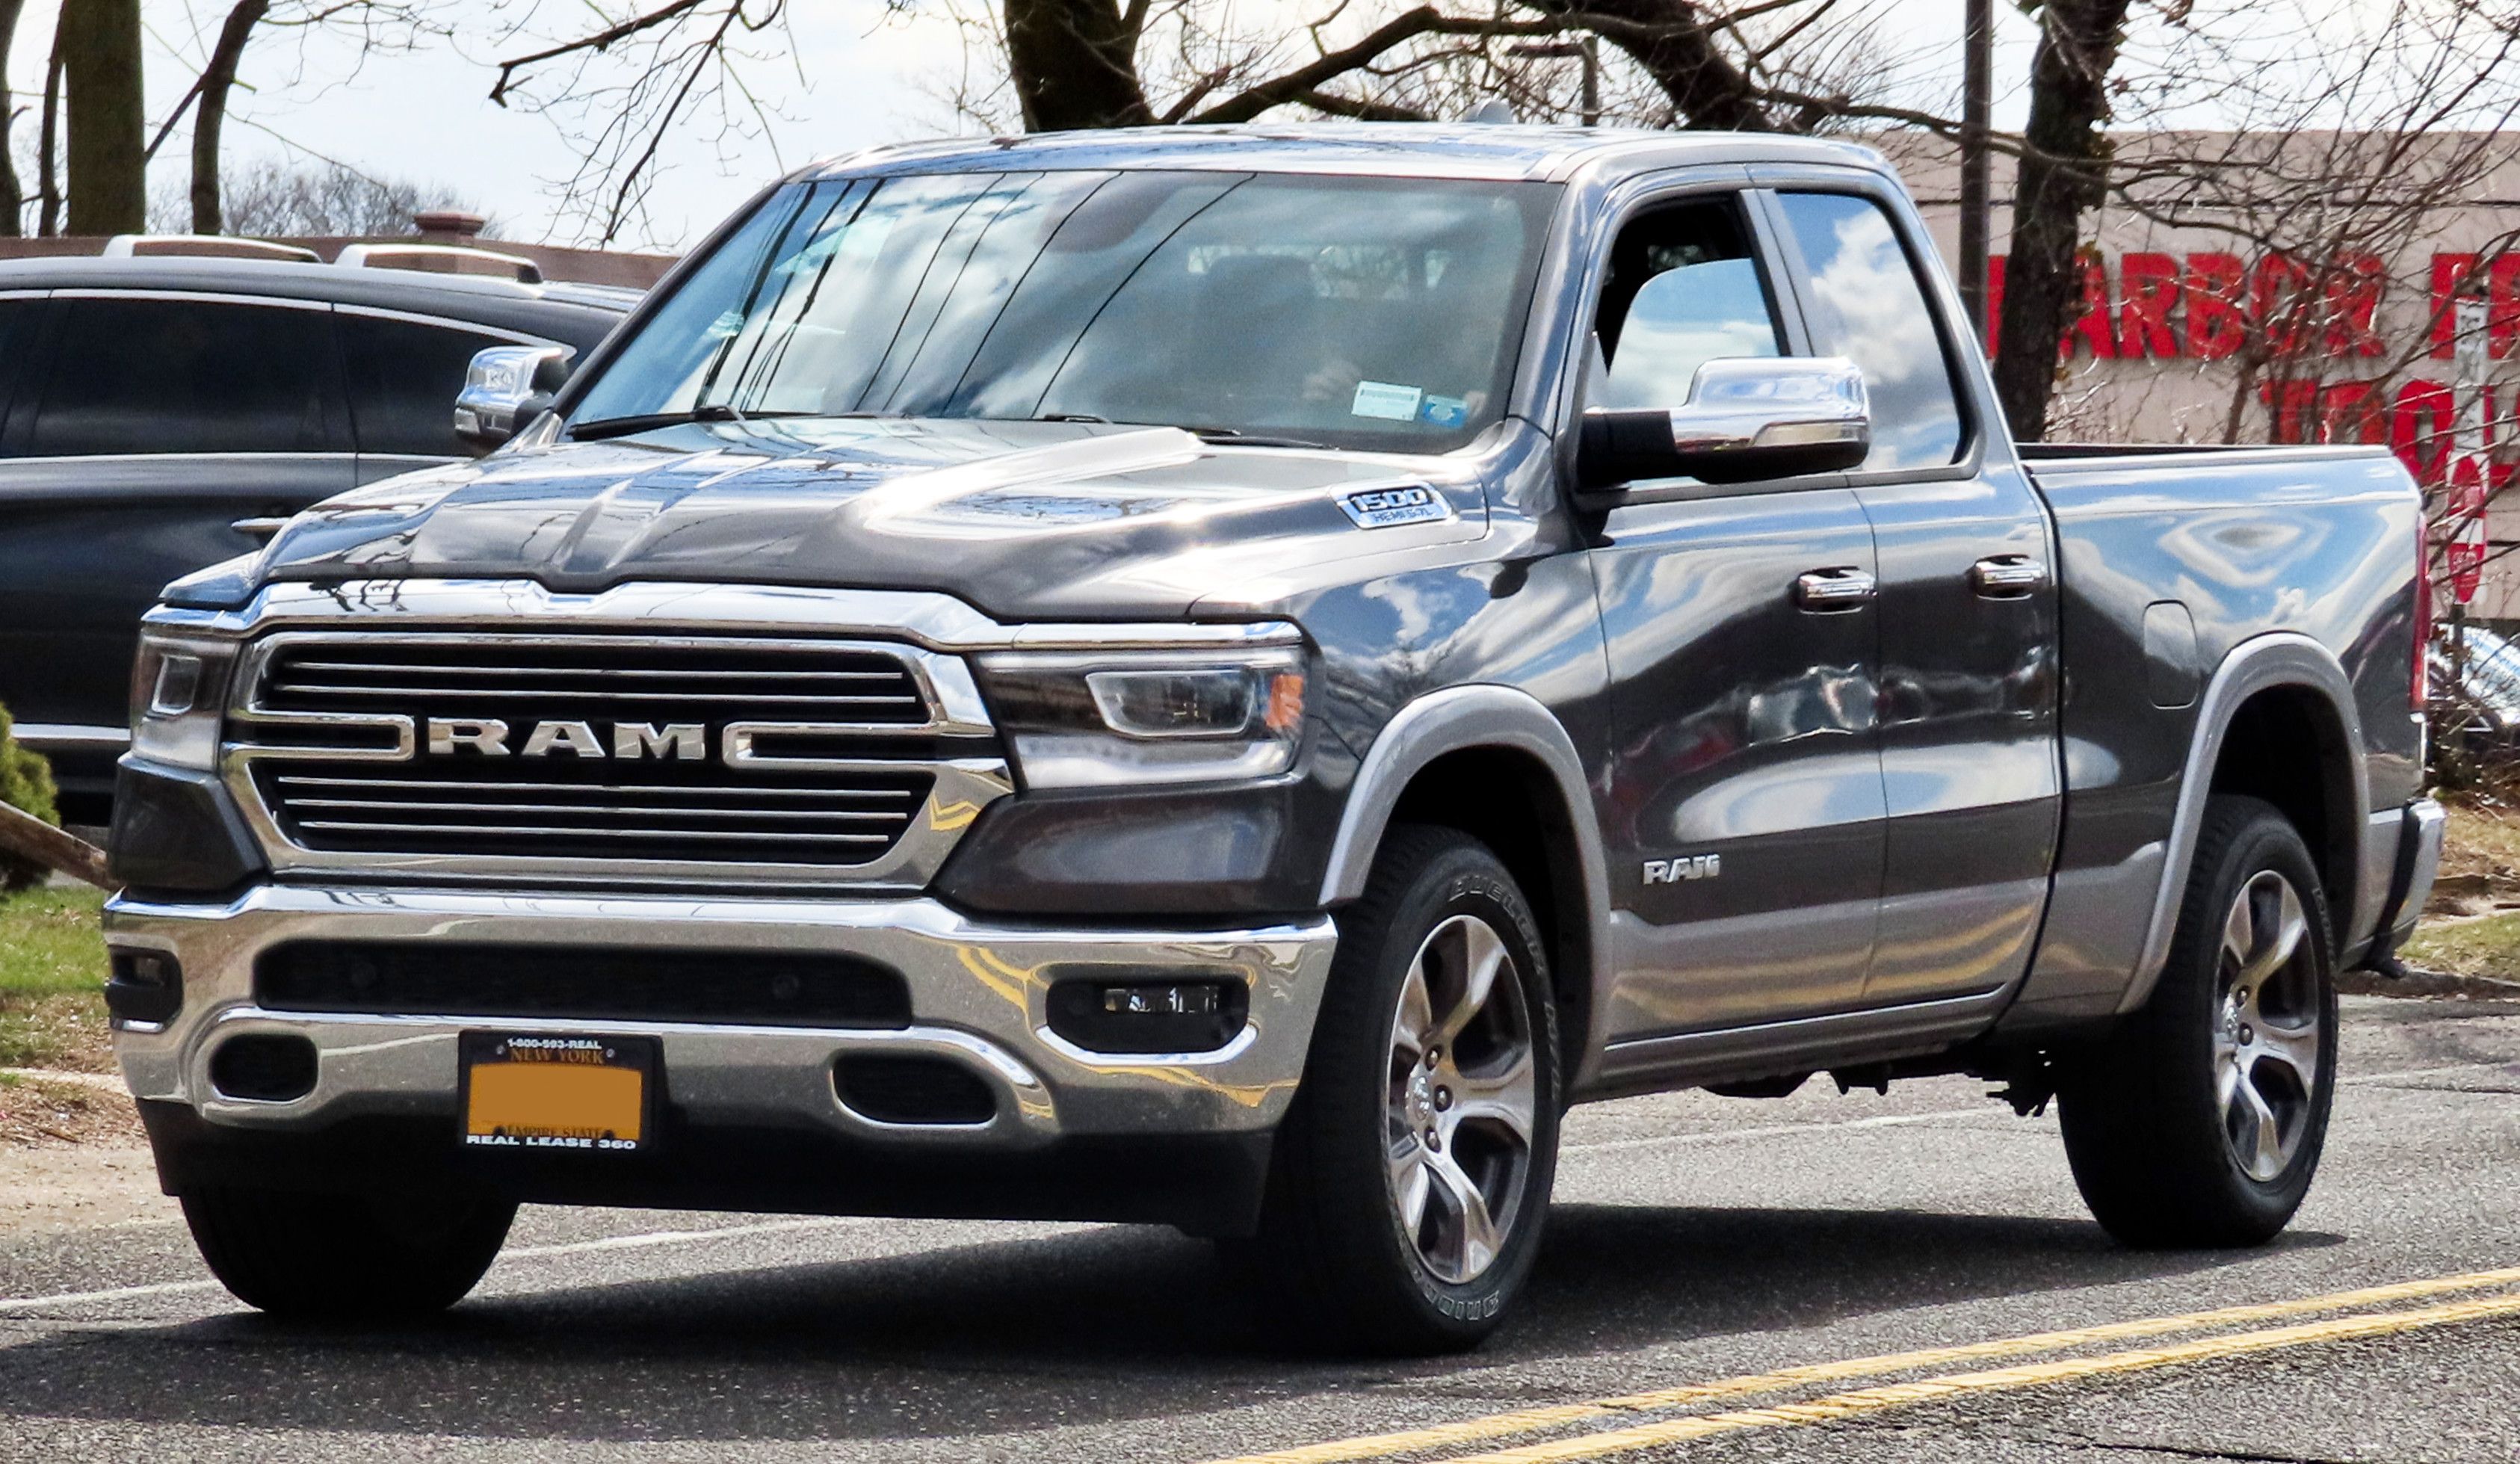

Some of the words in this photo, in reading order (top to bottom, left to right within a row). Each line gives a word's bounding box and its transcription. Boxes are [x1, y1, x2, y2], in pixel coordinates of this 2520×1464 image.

[1987, 252, 2386, 359] ARBOR
[1350, 488, 1429, 513] 1500
[428, 717, 705, 759] RAM
[1643, 853, 1720, 885] RAM
[510, 1047, 554, 1062] NEW
[558, 1048, 605, 1064] YORK
[466, 1134, 520, 1146] REAL
[525, 1137, 593, 1149] LEASE
[598, 1140, 637, 1150] 360
